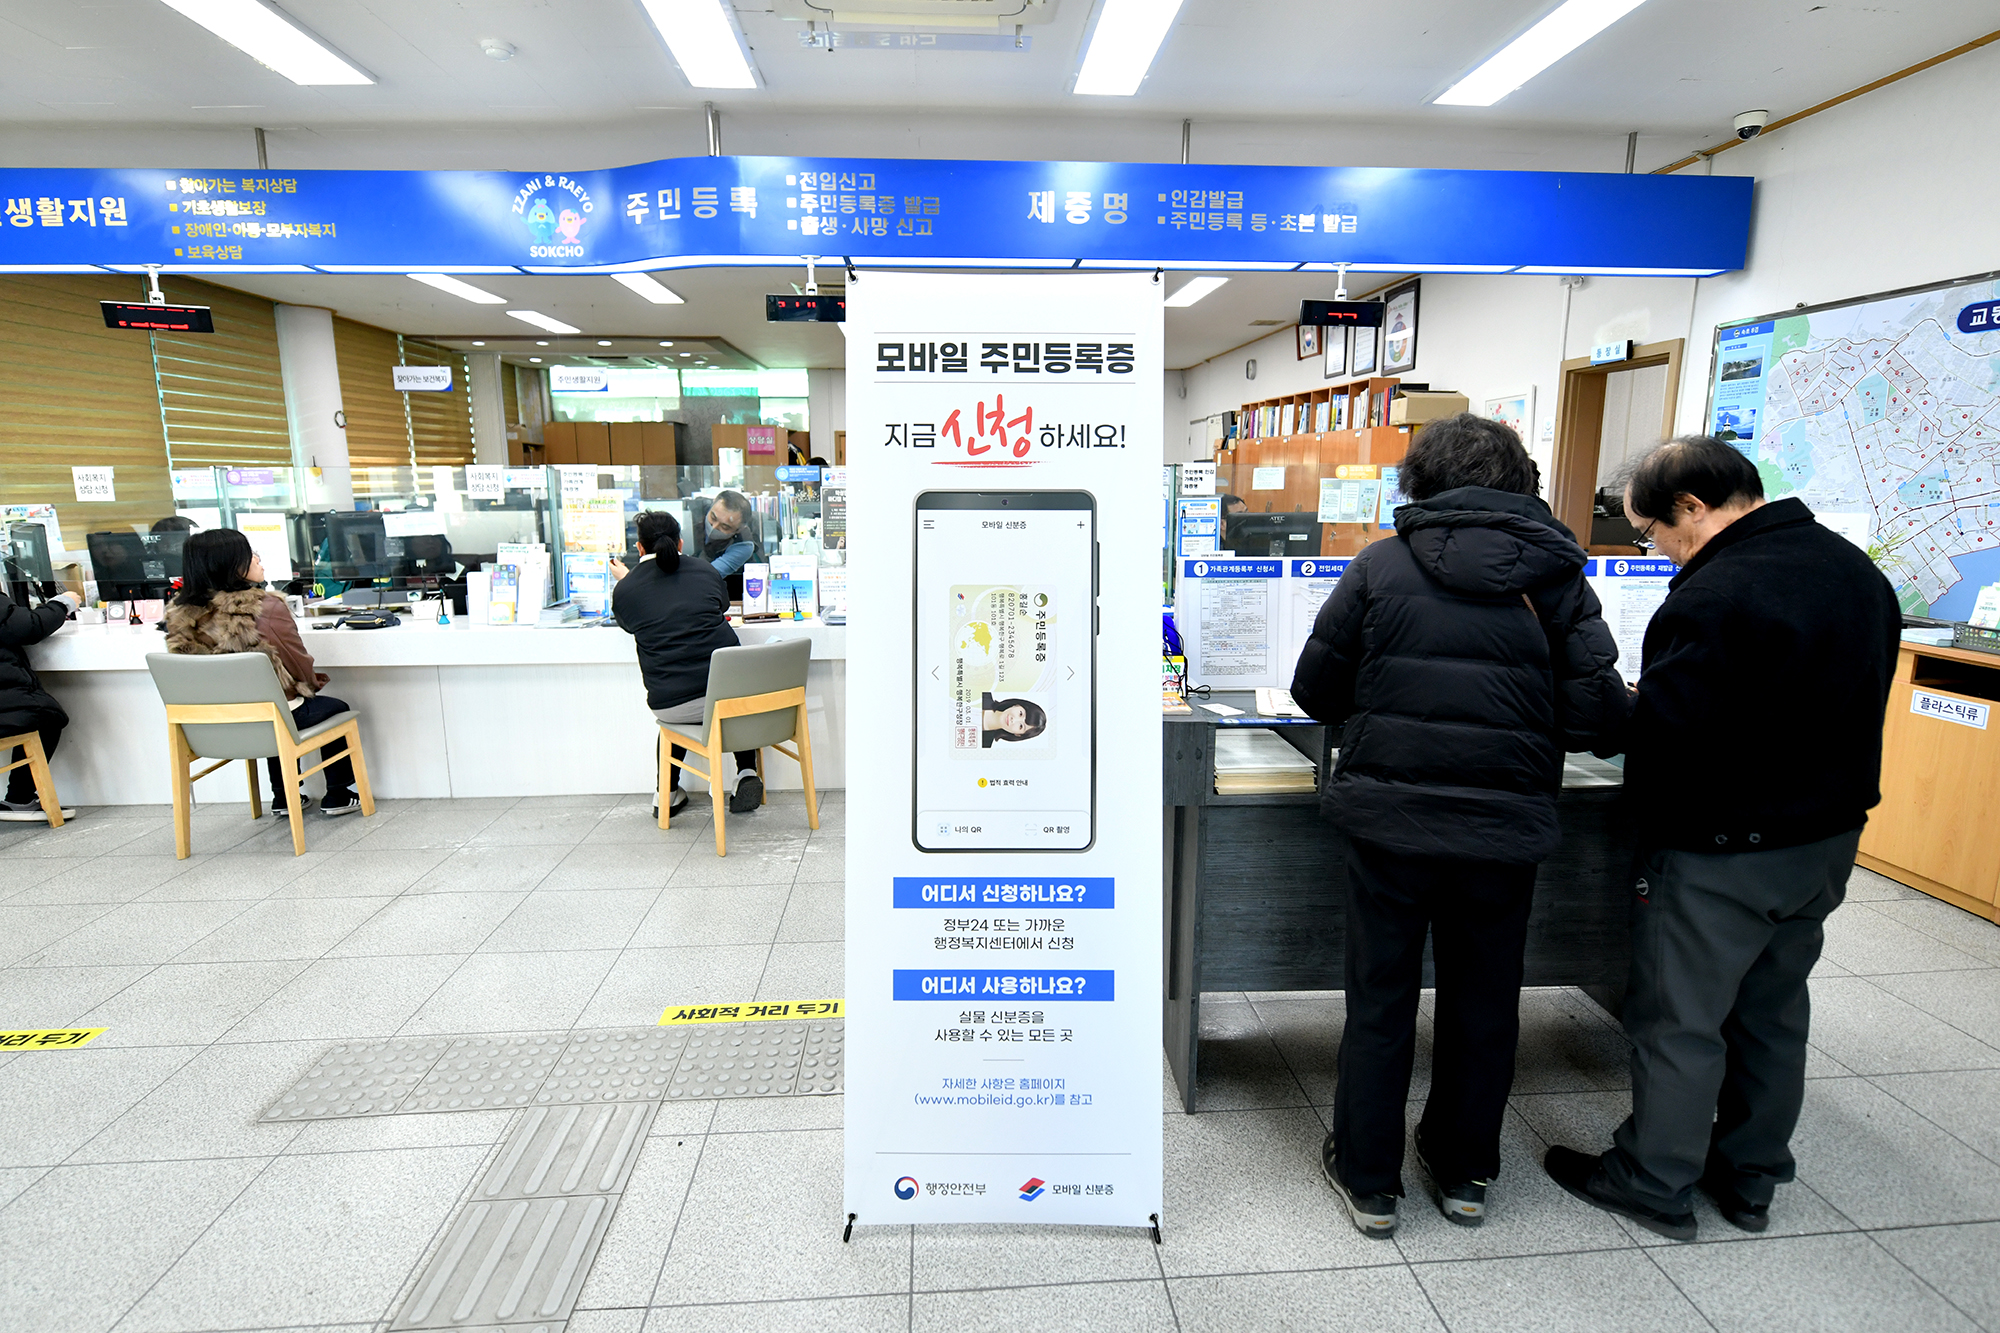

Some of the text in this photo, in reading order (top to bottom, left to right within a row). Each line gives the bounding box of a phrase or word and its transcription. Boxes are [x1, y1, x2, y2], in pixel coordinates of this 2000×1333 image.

[179, 177, 297, 194] 찾아가는 복지상담
[800, 172, 876, 191] 전입신고
[511, 175, 594, 214] ZZANI & RAEYO
[1171, 189, 1244, 209] 인감발급
[0, 196, 128, 228] 생활지원
[626, 186, 758, 224] 주민등록
[800, 193, 940, 214] 주민등록증 발급
[1027, 191, 1128, 224] 제증명
[896, 218, 933, 236] 신고
[1171, 212, 1243, 231] 주민등록
[1322, 214, 1358, 233] 발급
[187, 245, 243, 260] 보육상담
[529, 245, 585, 258] SOKCHO
[876, 342, 1135, 374] 모바일 주민등록증
[884, 393, 1126, 458] 지금 신청 하세요!
[981, 520, 1027, 530] 모바일 신분증
[1007, 592, 1015, 659] 820701-2345678
[1035, 610, 1047, 662] 주민등록증
[1920, 696, 1979, 721] 플라스틱류
[1016, 779, 1028, 787] 안내
[954, 825, 982, 834] 나의 QR
[1043, 825, 1054, 834] QR
[921, 884, 1086, 903] 어디서 신청하나요?
[943, 919, 1065, 932] 정부24 또는 가까운
[934, 937, 1074, 950] 행정복지센터에서 신청
[921, 976, 1086, 995] 어디서 사용하나요?
[672, 1003, 839, 1020] 사회적 거리 두기
[959, 1010, 1045, 1024] 실물 신분증을
[35, 1032, 91, 1046] 두기
[934, 1029, 1073, 1042] 사용할 수 있는 모든 곳
[942, 1078, 1065, 1090] 자세한 사항은 홈페이지
[1069, 1093, 1093, 1106] 참고
[925, 1182, 987, 1196] 행정안전부
[1052, 1184, 1114, 1196] 모바일 신분증
